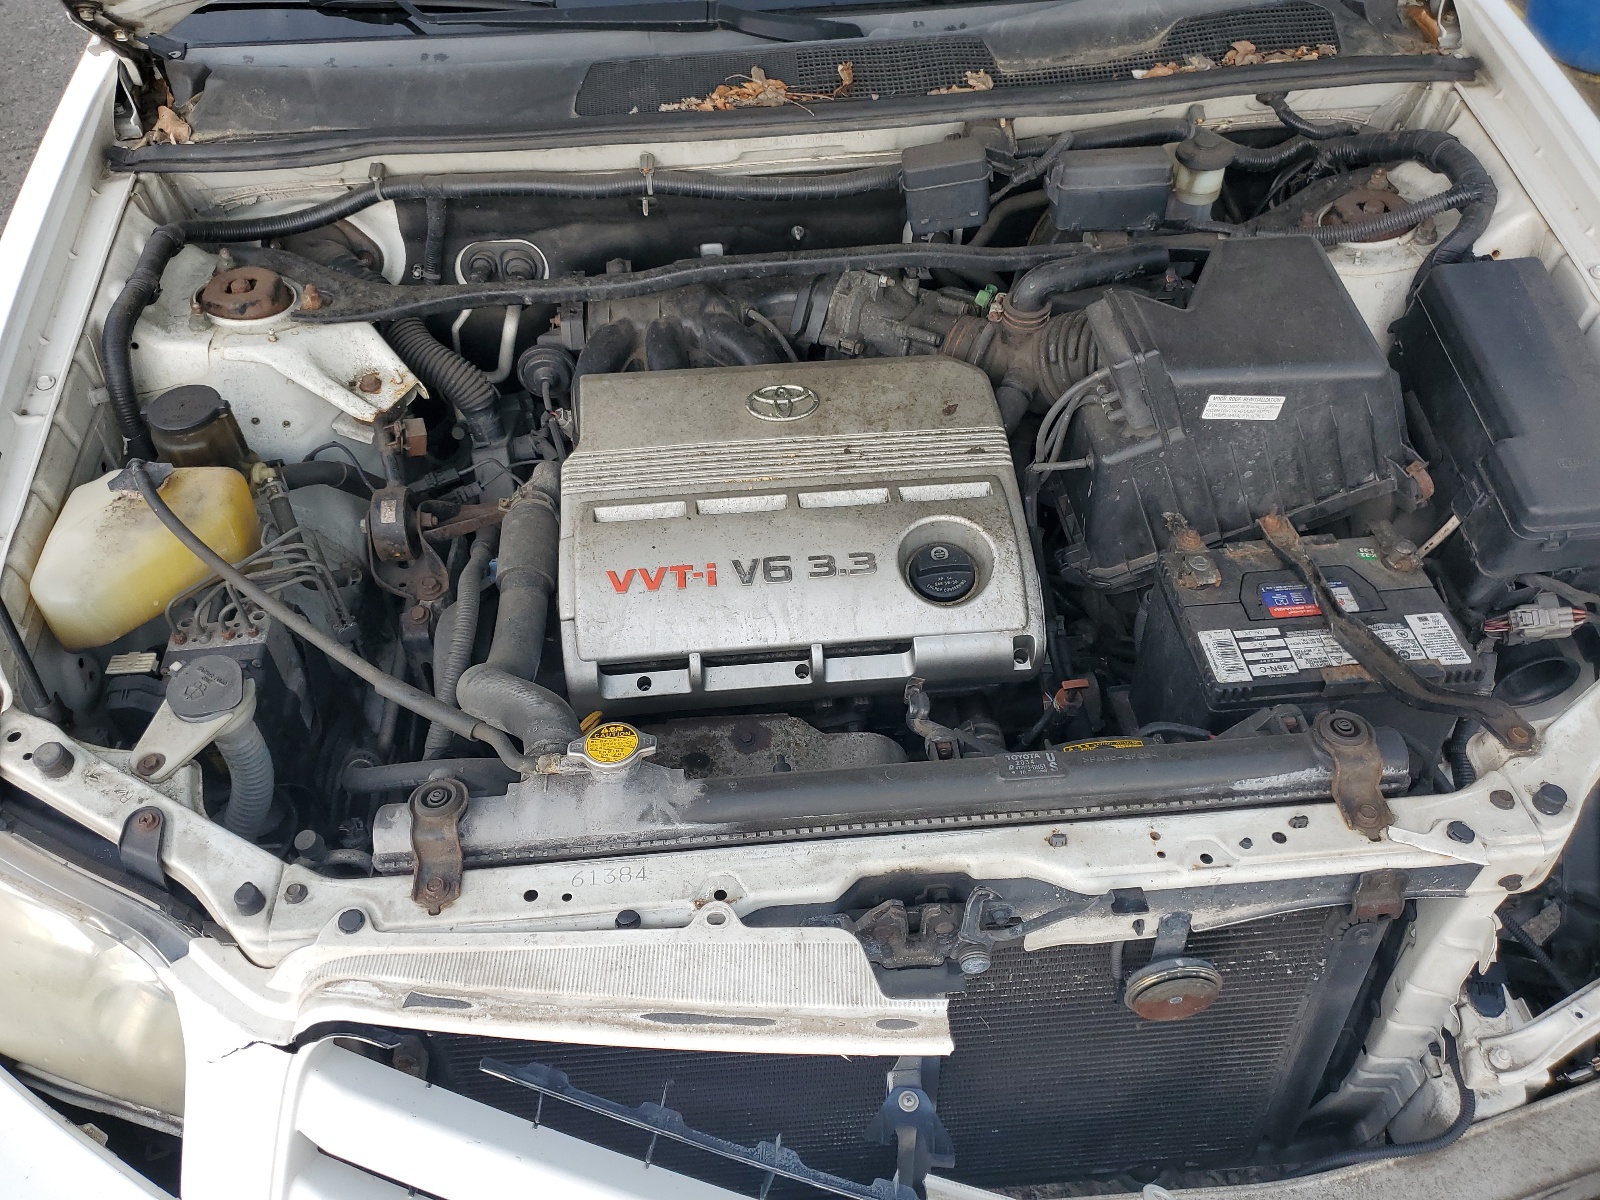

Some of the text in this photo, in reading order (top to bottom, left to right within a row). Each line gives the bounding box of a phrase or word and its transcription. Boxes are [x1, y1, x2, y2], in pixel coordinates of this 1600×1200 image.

[606, 552, 878, 595] VVT-i V6 3.3
[1004, 753, 1041, 761] TOYOTA
[571, 865, 647, 888] 61384
